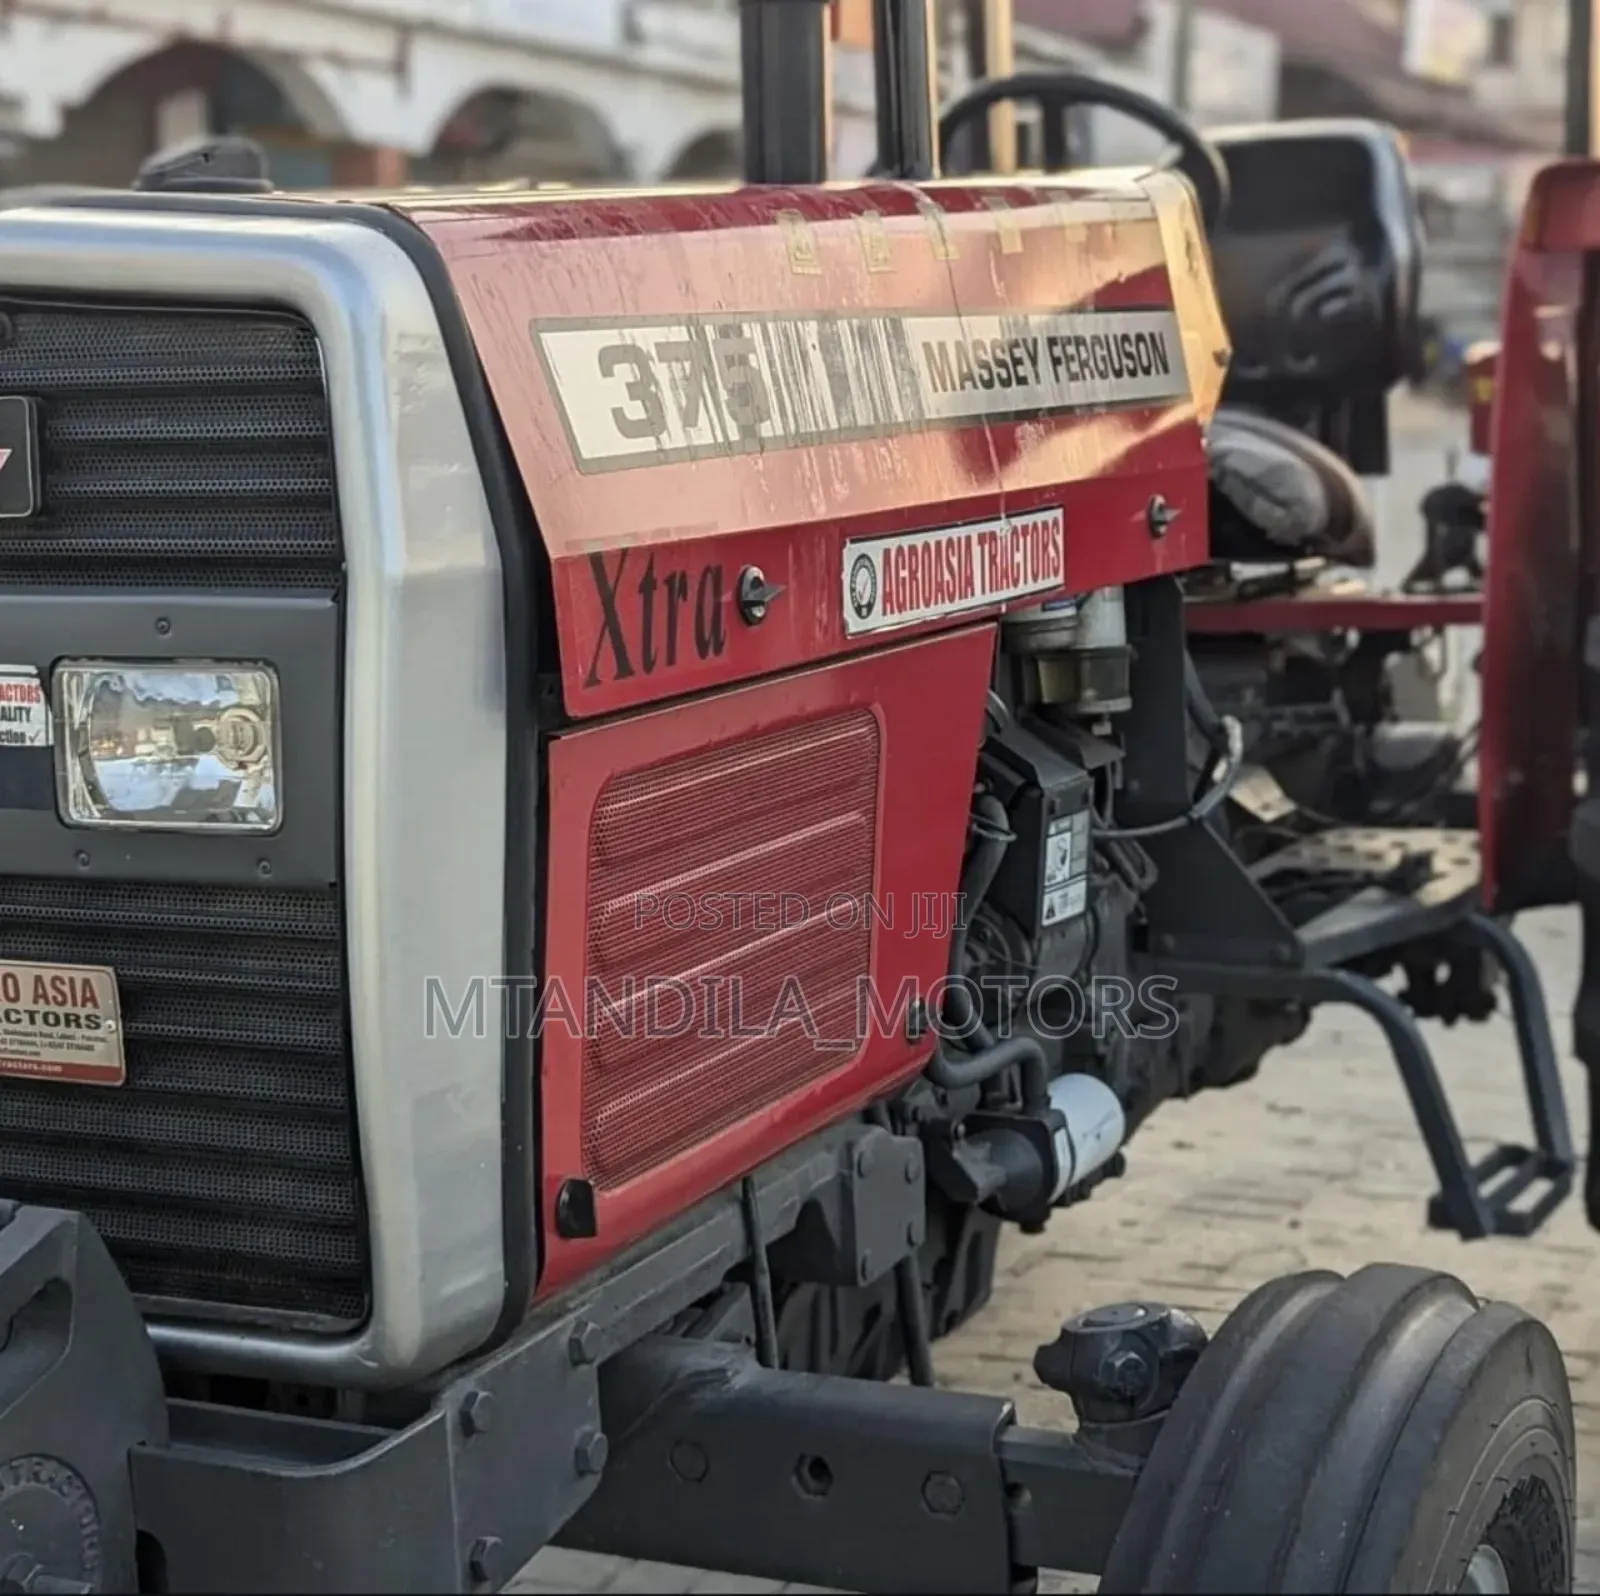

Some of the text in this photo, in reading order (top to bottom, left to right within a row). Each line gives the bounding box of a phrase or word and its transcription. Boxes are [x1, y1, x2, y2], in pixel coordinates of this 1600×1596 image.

[598, 336, 772, 440] 375
[921, 331, 1170, 393] MASSEY FERGUSON
[882, 534, 975, 617] AGROASIA
[977, 515, 1061, 595] TRACTORS
[583, 547, 726, 689] Xtra
[0, 971, 100, 1009] O ASIA
[0, 1008, 101, 1030] CTORS
